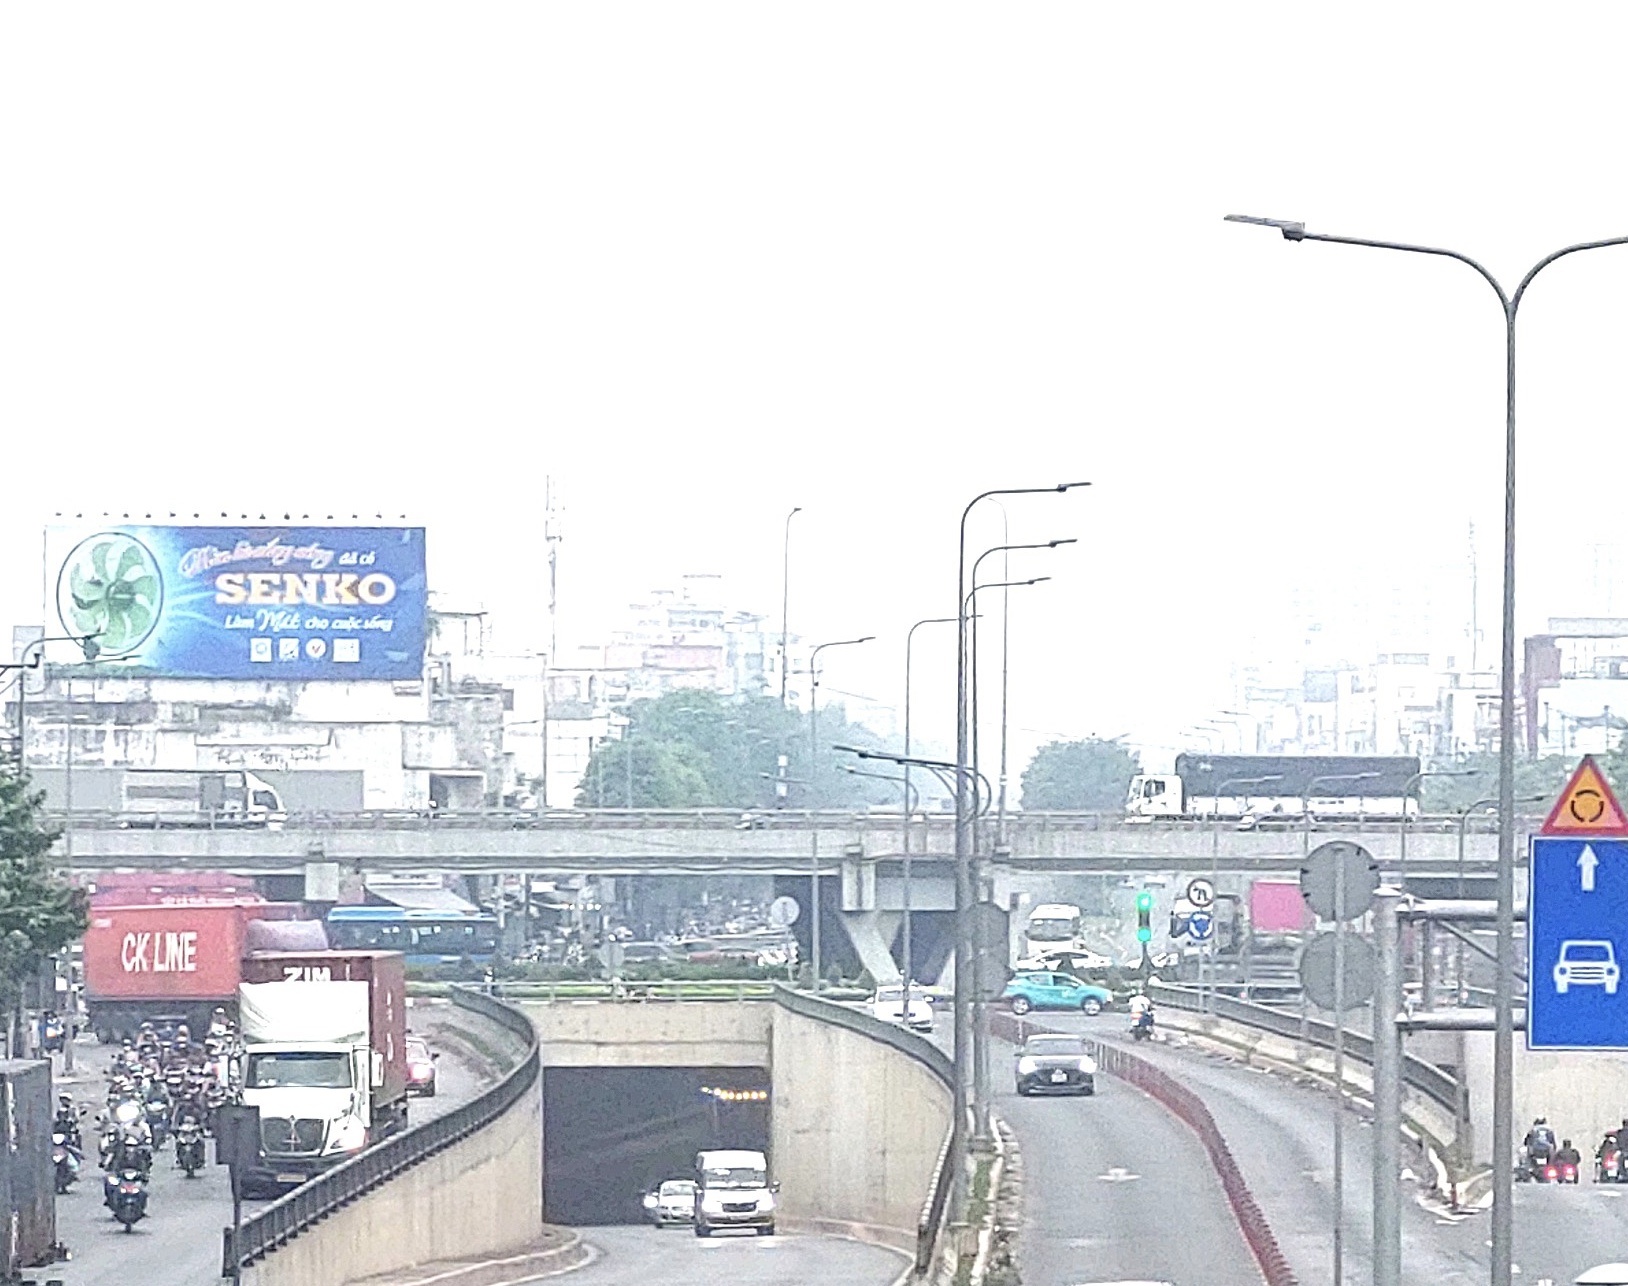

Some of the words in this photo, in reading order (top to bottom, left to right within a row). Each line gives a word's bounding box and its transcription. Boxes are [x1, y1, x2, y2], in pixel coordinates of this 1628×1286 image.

[215, 572, 396, 604] SENKO
[121, 932, 150, 971] CK
[153, 931, 198, 972] LINE
[283, 967, 331, 982] ZIM
